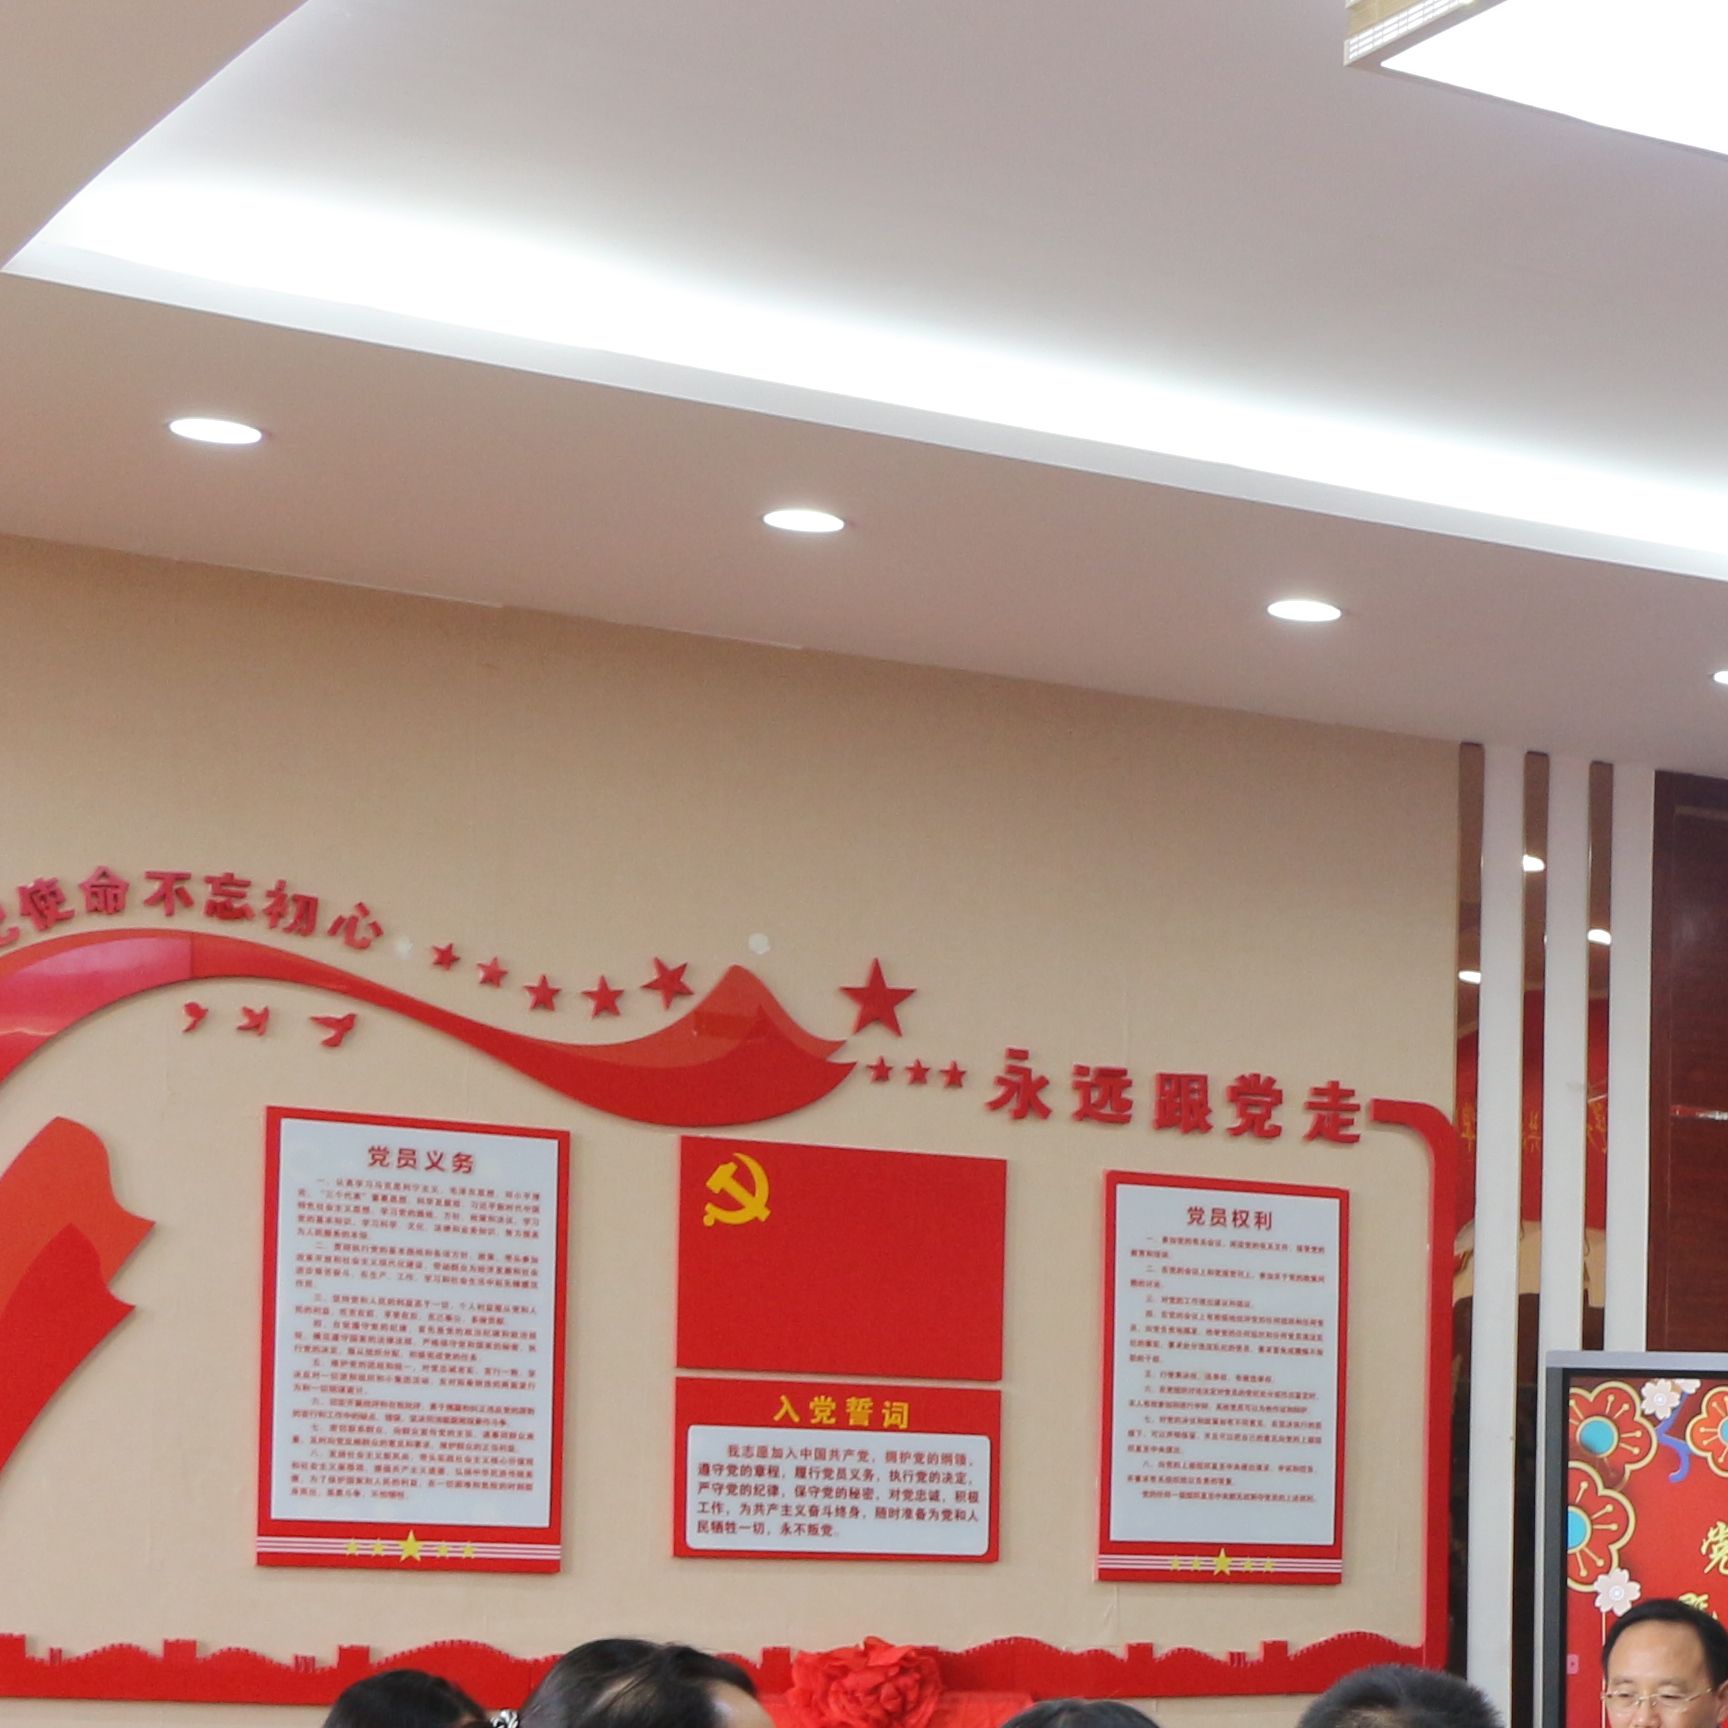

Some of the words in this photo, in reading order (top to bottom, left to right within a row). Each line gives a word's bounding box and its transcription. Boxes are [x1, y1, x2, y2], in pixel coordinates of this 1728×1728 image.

[986, 1046, 1362, 1144] 永远跟党走
[368, 1145, 475, 1174] 党员义务
[1187, 1205, 1273, 1231] 党员权利
[772, 1394, 910, 1430] 入党誓词
